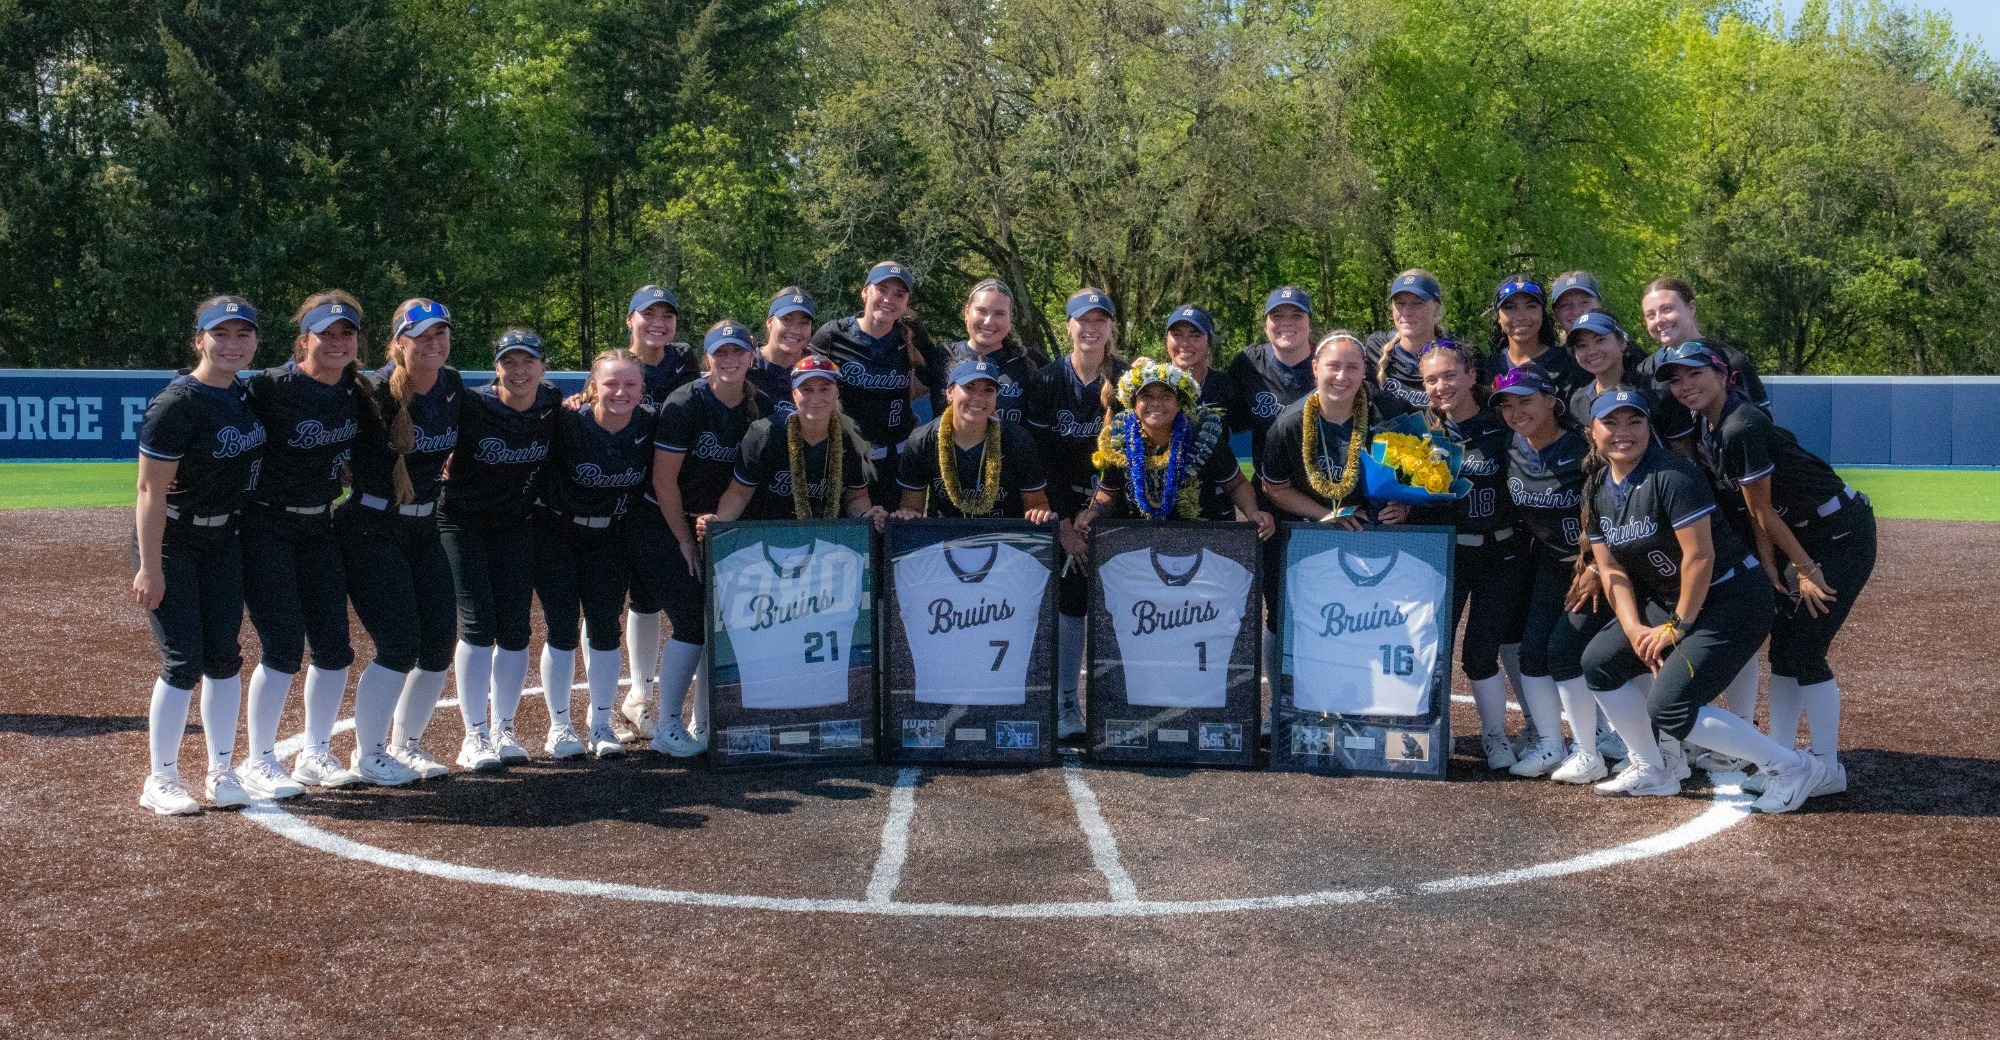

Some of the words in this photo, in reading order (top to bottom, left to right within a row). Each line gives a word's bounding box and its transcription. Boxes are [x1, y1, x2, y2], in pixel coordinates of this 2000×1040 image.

[0, 396, 103, 440] ORGE
[888, 399, 904, 427] 2
[1468, 487, 1496, 517] 18
[1509, 477, 1581, 508] Bruins
[1562, 517, 1582, 546] 8
[1648, 550, 1677, 577] 9
[750, 589, 835, 632] Bruins
[927, 597, 1016, 635] Bruins
[1131, 600, 1219, 637] Bruins
[1318, 602, 1408, 638] Bruins
[804, 630, 839, 664] 21
[989, 640, 1010, 672] 7
[1194, 641, 1207, 672] 1
[1379, 644, 1415, 676] 16
